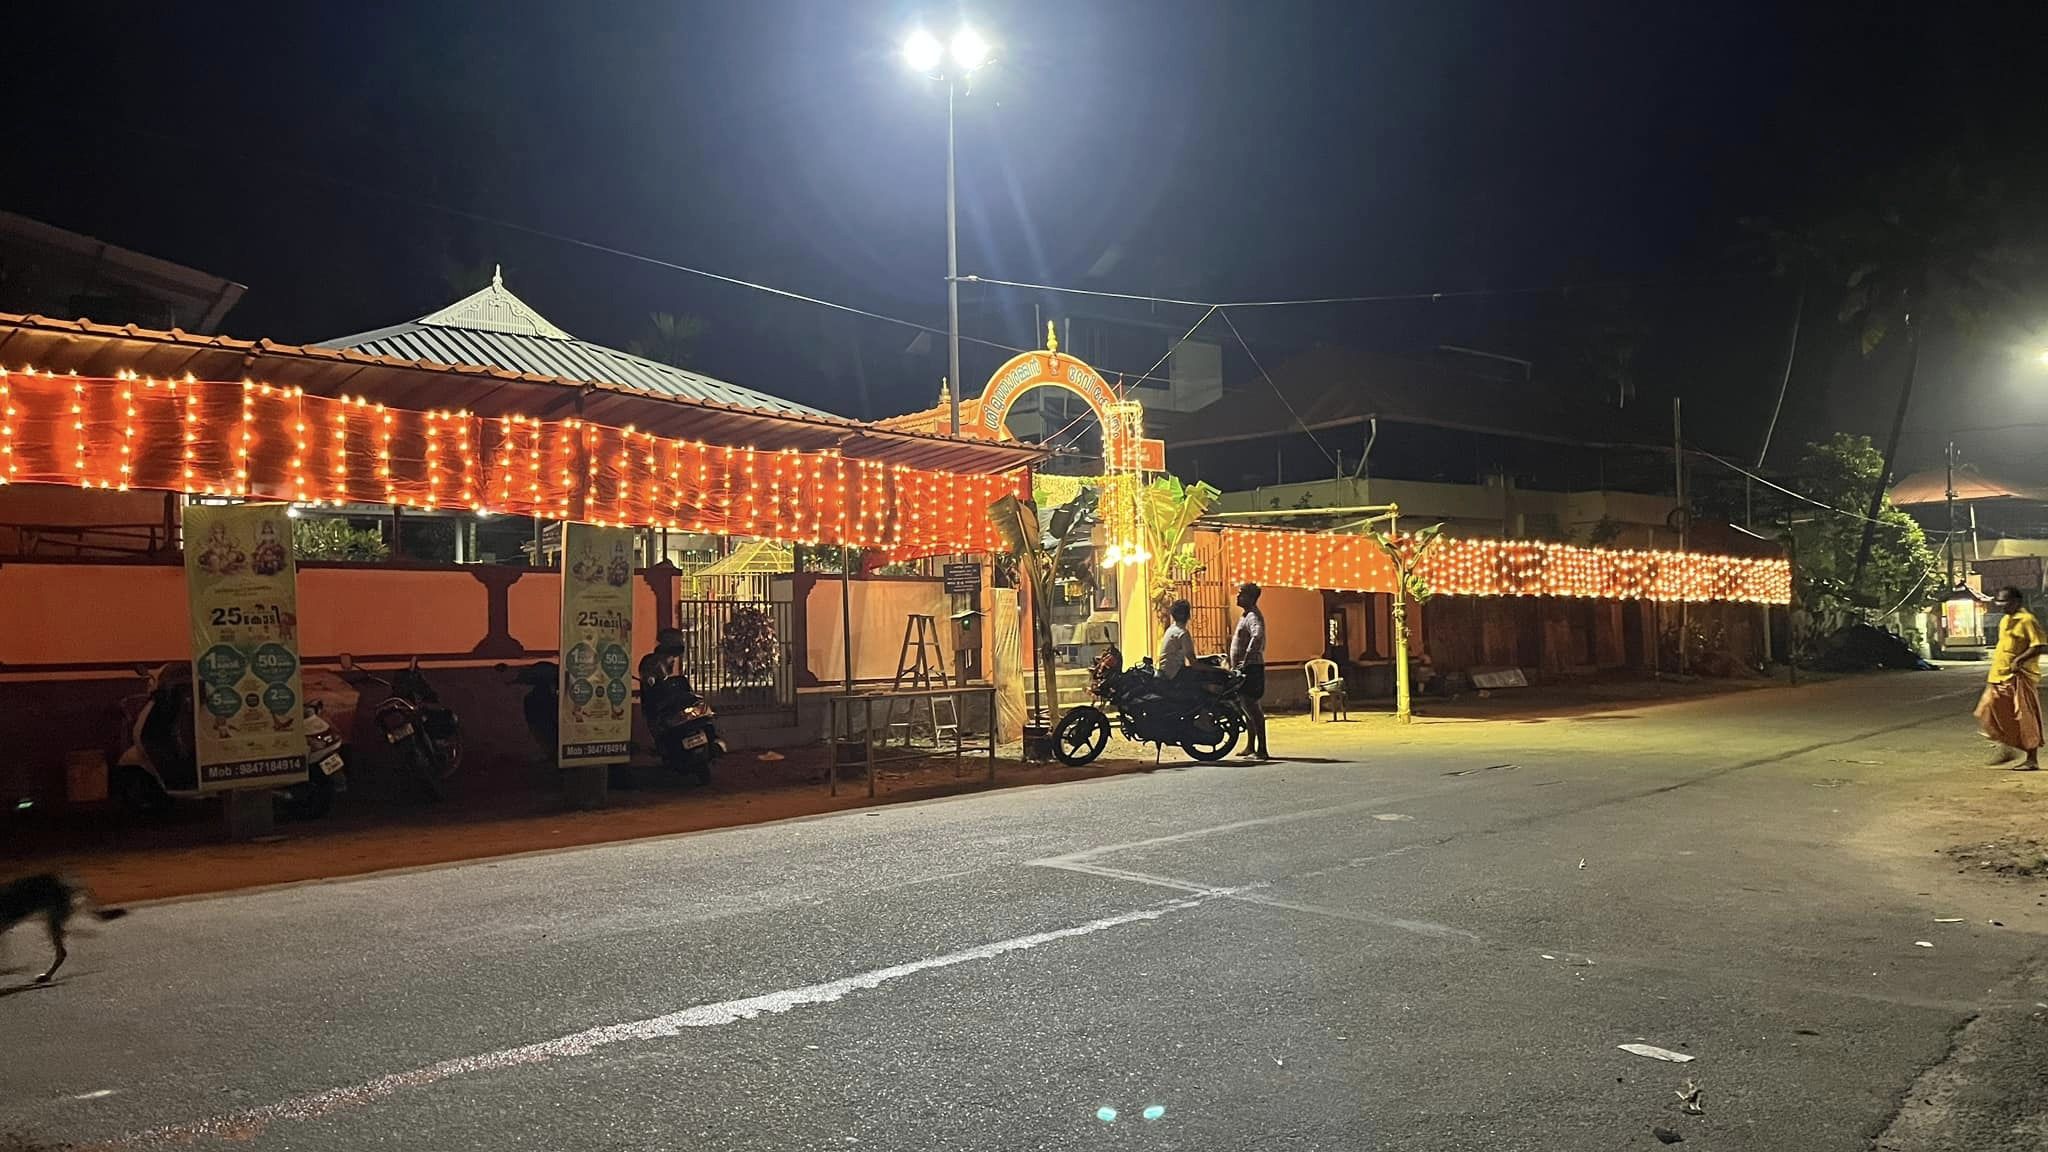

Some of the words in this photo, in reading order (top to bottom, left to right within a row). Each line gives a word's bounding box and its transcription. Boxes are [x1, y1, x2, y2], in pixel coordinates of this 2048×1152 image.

[211, 607, 242, 625] 25
[577, 611, 599, 627] 25
[206, 652, 217, 670] 1
[258, 654, 277, 668] 50
[606, 653, 618, 665] 50
[212, 694, 222, 705] 5
[271, 689, 279, 700] 2
[567, 745, 583, 755] Mob
[208, 766, 232, 778] Mob
